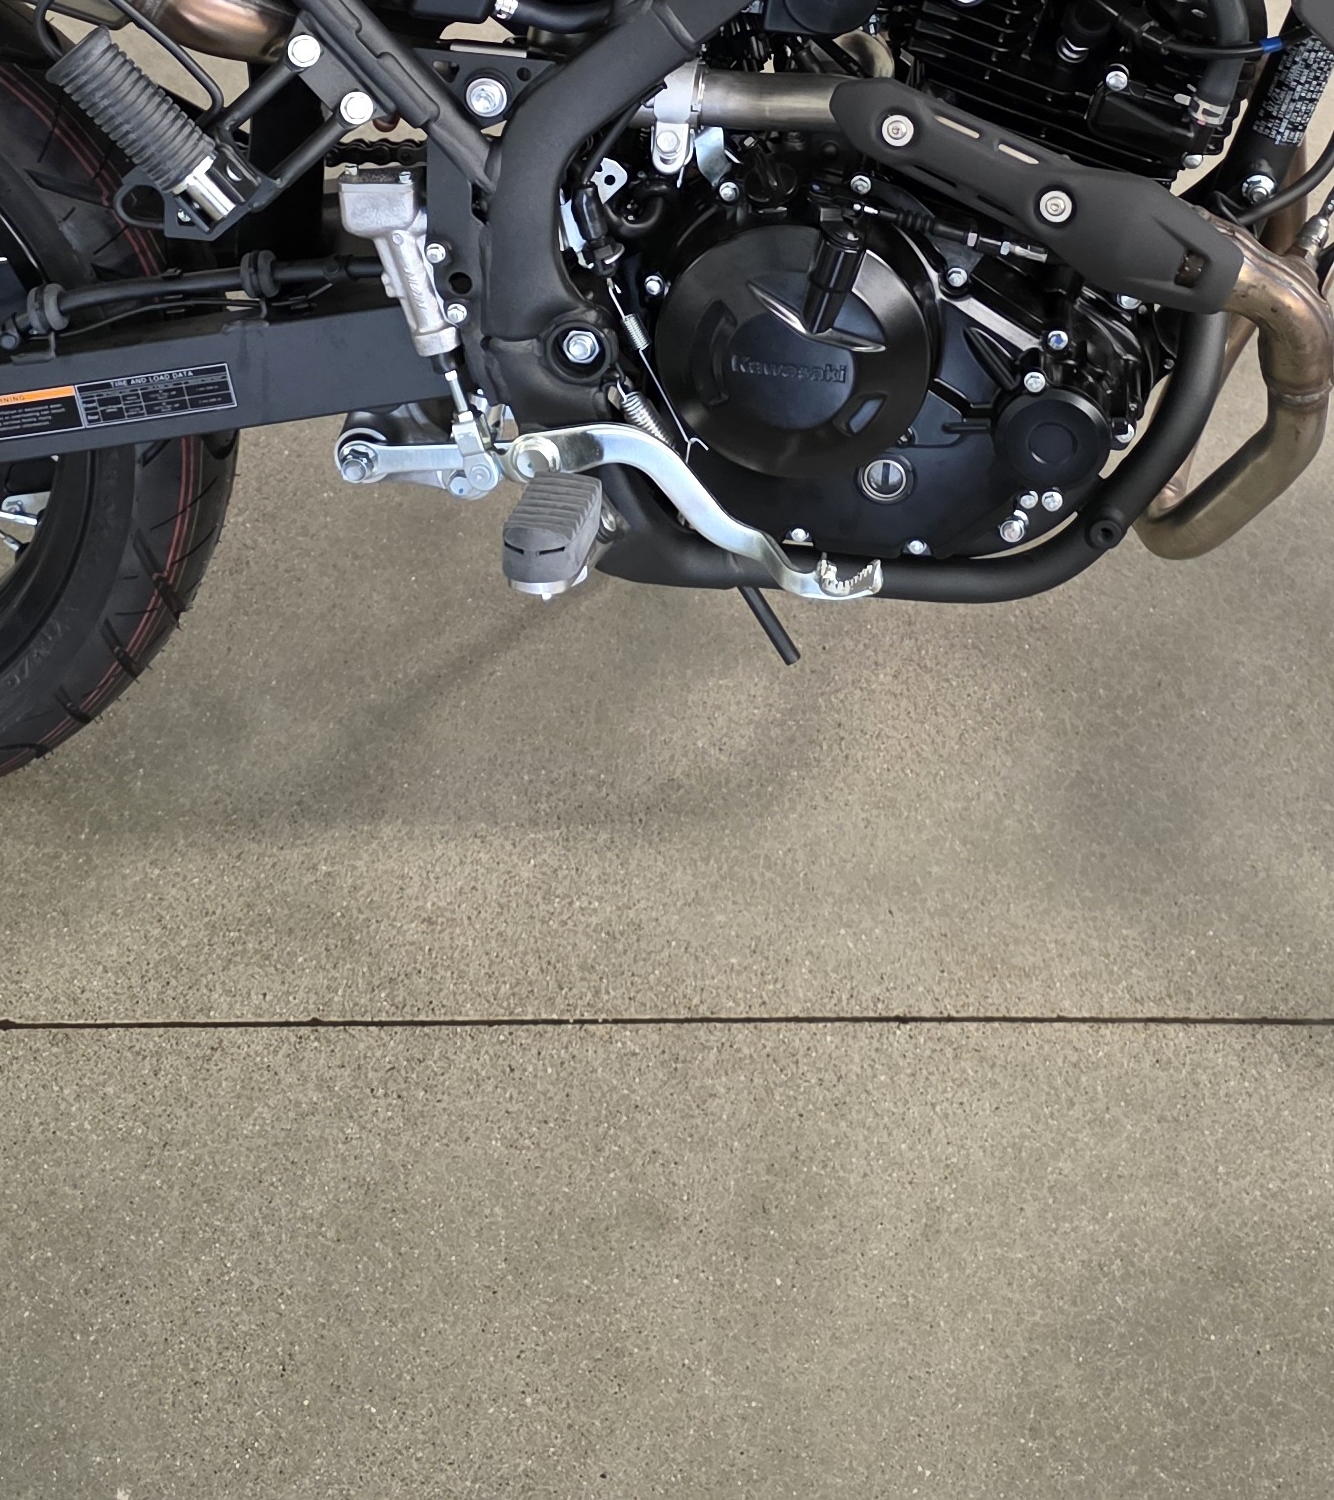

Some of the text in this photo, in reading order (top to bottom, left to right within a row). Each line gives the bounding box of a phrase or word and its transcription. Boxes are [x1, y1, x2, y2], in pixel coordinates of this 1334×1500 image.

[130, 377, 148, 386] AND
[149, 373, 171, 383] LOAD
[172, 370, 194, 380] DATA
[730, 354, 848, 383] Kawasaki
